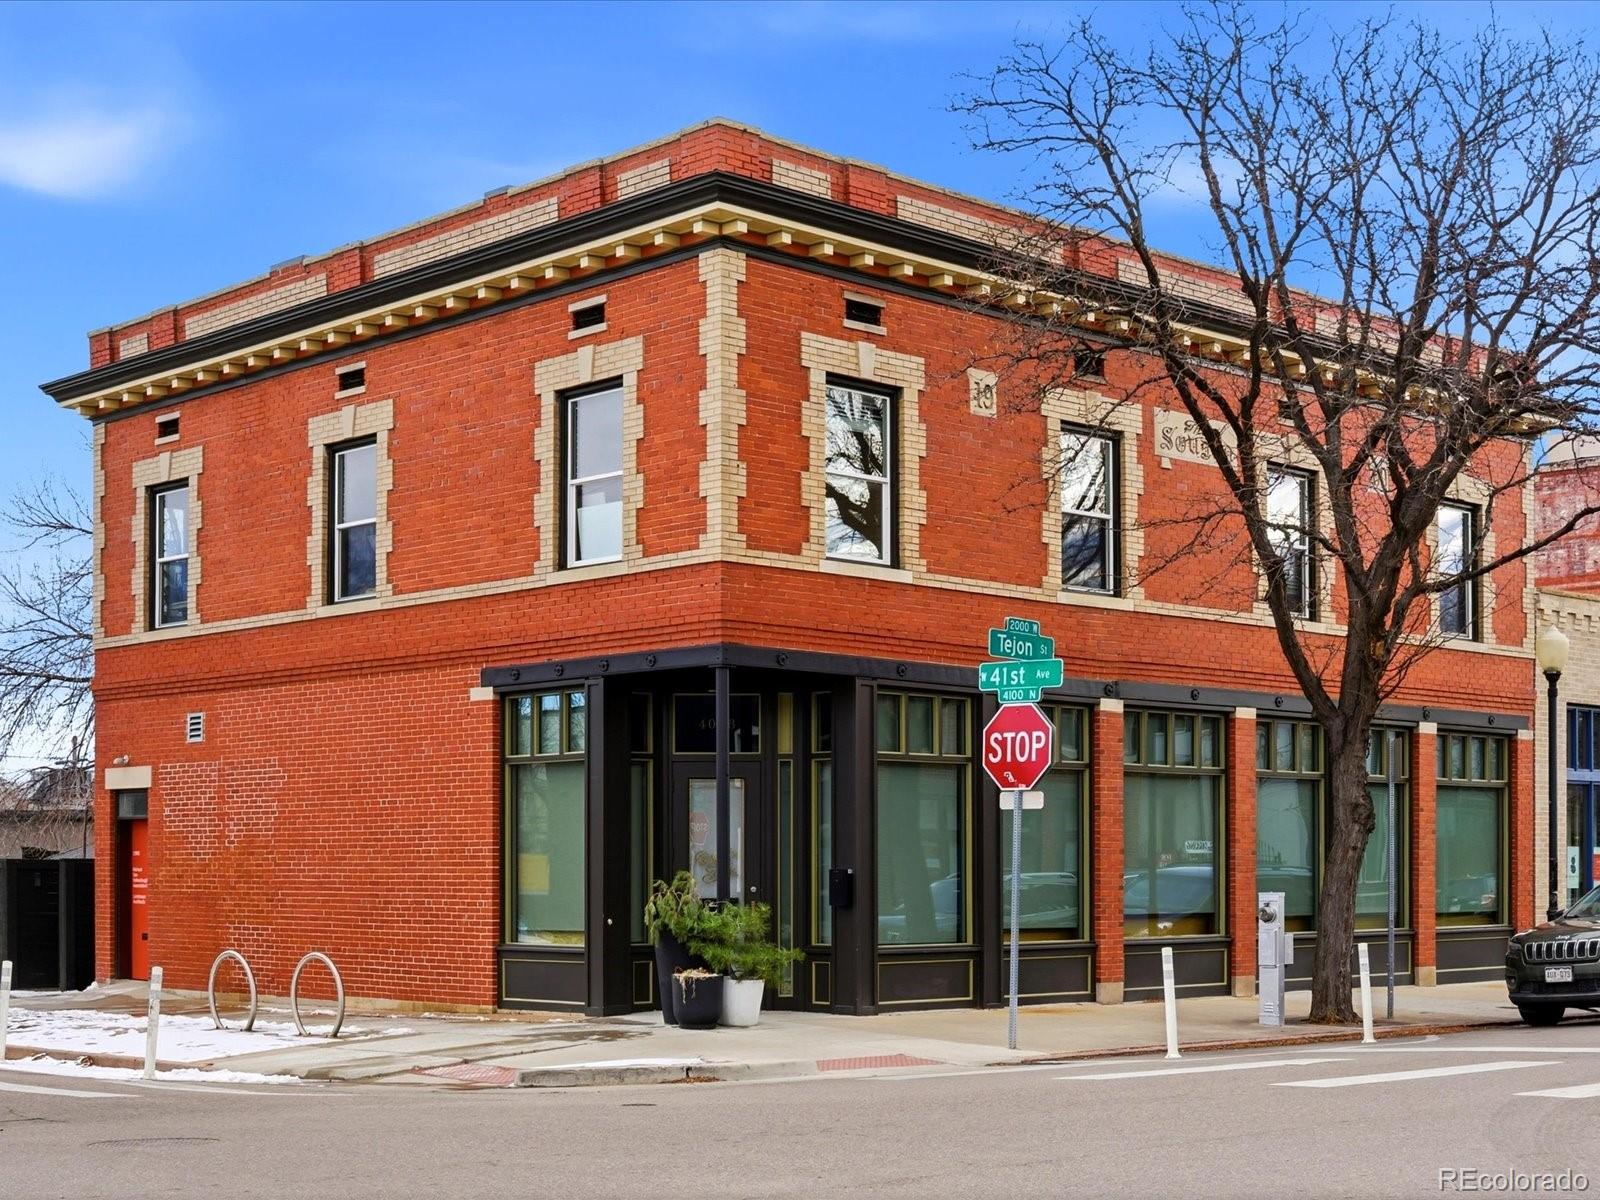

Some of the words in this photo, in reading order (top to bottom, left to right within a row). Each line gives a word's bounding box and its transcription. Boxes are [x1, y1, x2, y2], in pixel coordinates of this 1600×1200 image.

[973, 381, 994, 409] 19
[1010, 620, 1029, 632] 2000
[997, 633, 1033, 657] Tejon
[1040, 644, 1047, 655] St
[990, 667, 1025, 686] 41st
[1035, 669, 1050, 679] Ave
[1003, 689, 1023, 701] 4100
[1029, 690, 1036, 699] N
[988, 731, 1046, 763] STOP
